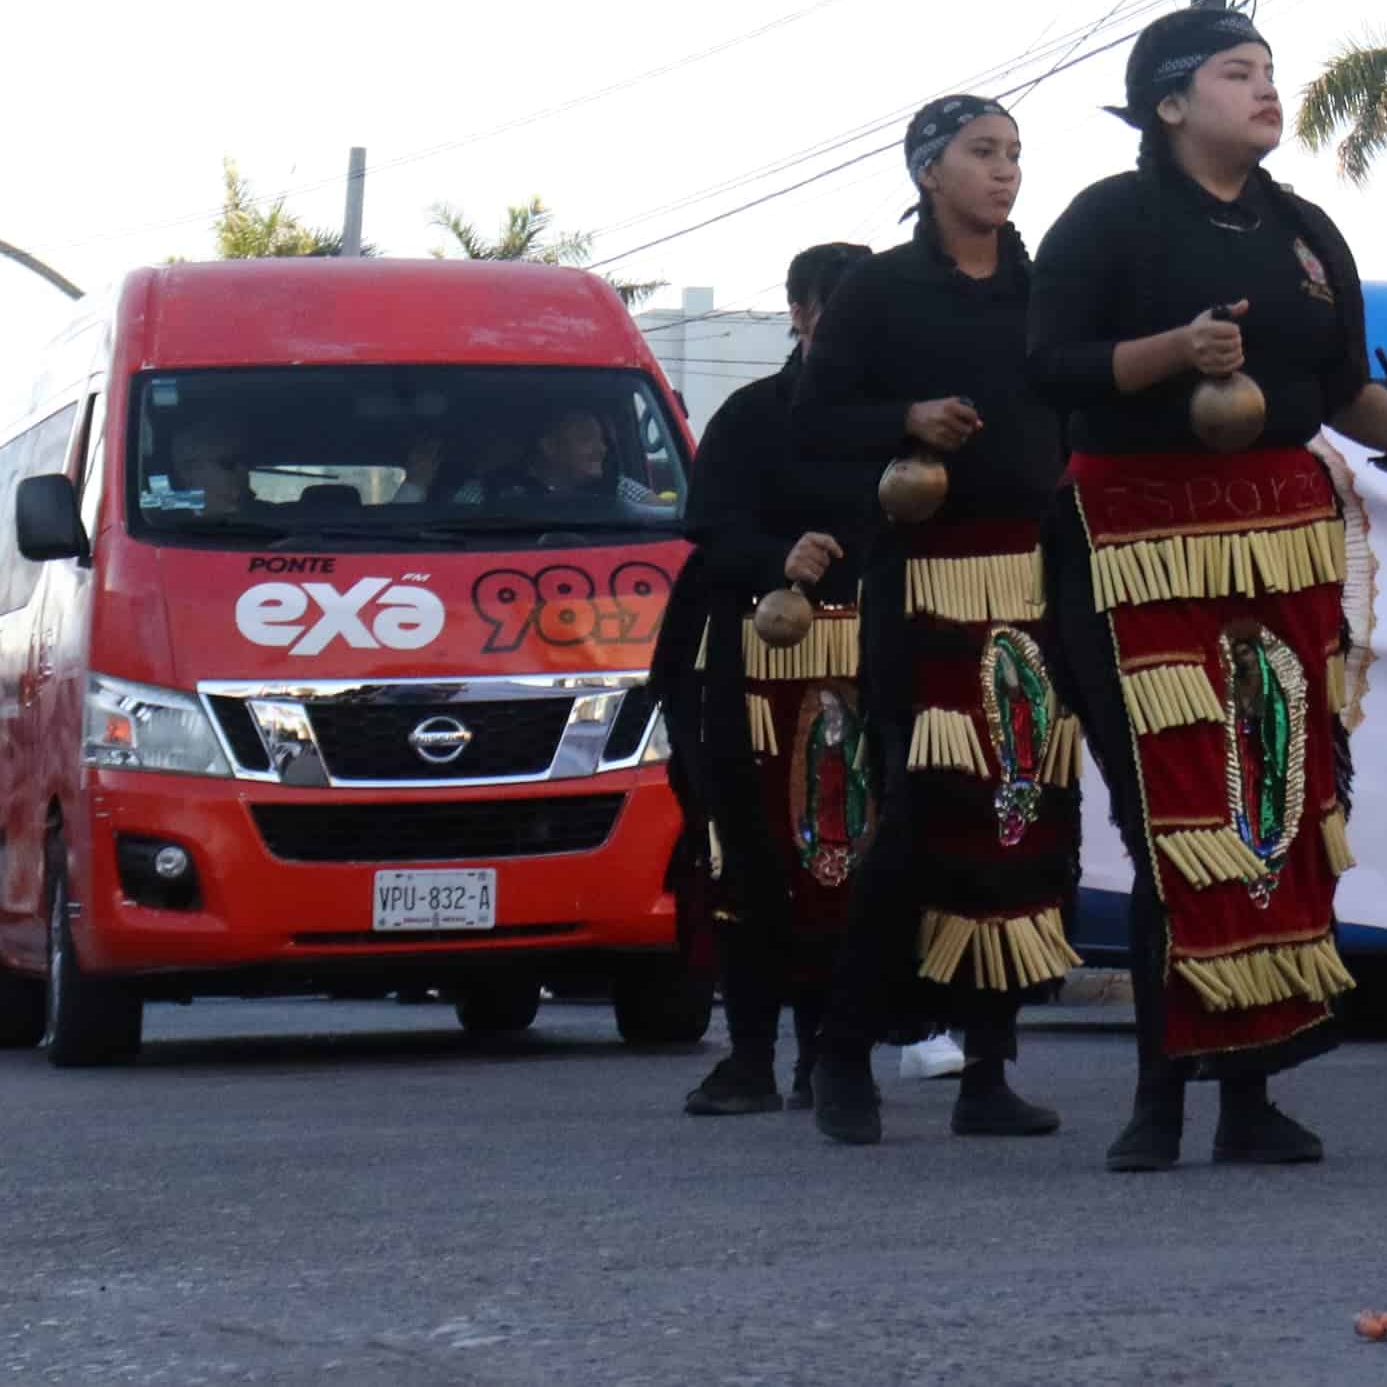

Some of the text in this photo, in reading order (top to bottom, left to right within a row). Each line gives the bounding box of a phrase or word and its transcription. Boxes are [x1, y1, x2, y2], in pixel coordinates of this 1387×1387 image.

[248, 556, 336, 575] PONTE
[402, 572, 430, 583] FM
[471, 560, 674, 655] 98.9
[379, 885, 490, 911] VPU-832-A
